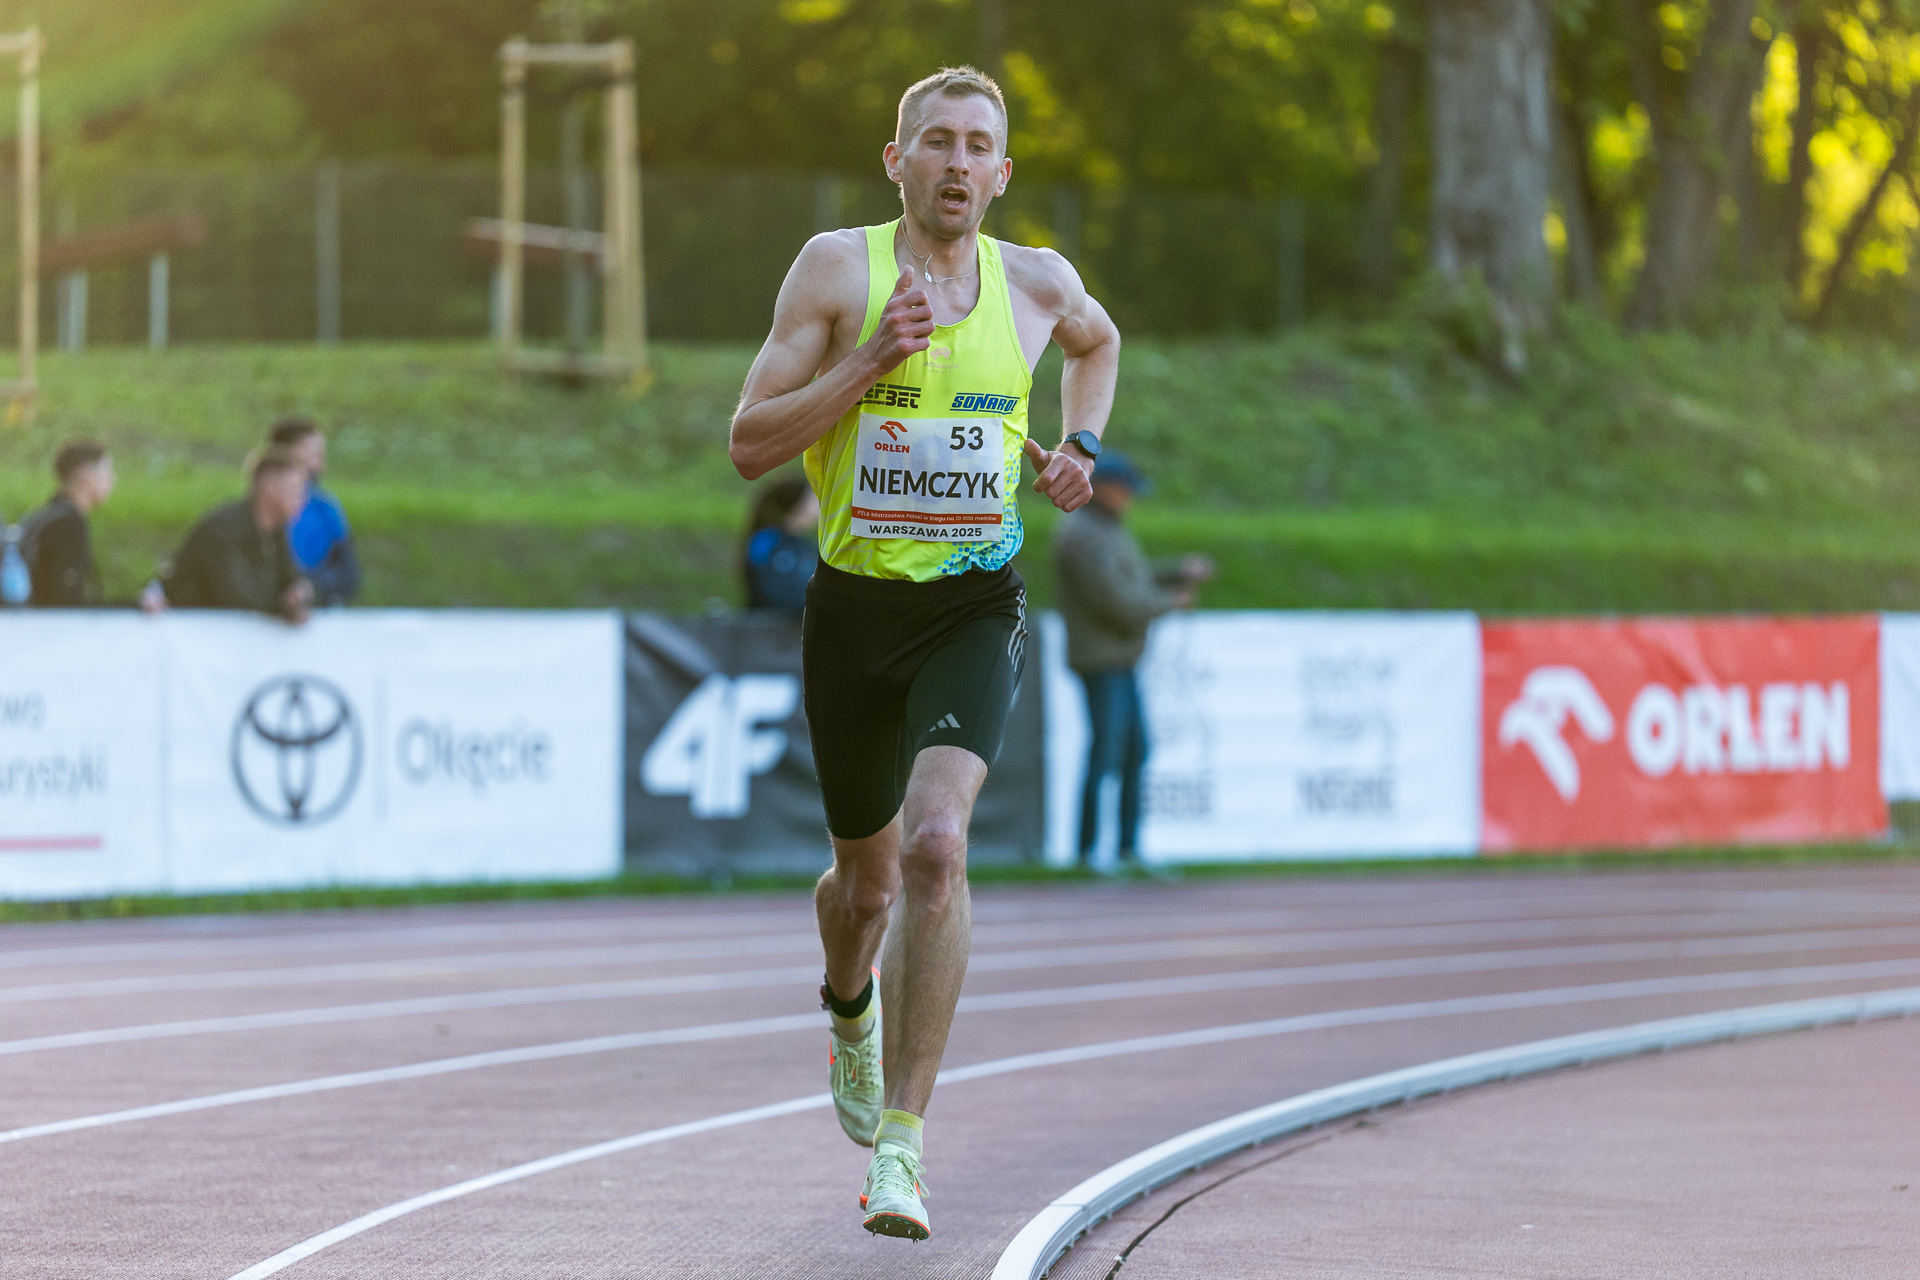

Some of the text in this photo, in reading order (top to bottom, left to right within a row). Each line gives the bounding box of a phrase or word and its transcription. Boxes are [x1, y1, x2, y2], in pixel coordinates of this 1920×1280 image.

[862, 382, 921, 409] EFBET
[950, 393, 1019, 414] SONAROL
[874, 441, 910, 453] ORLEN
[950, 426, 984, 450] 53
[859, 464, 1000, 499] NIEMCZYK
[869, 524, 982, 537] WARSZAWA 2025
[1627, 680, 1850, 776] ORLEN
[397, 714, 554, 791] Okęcie
[641, 671, 799, 820] 4F
